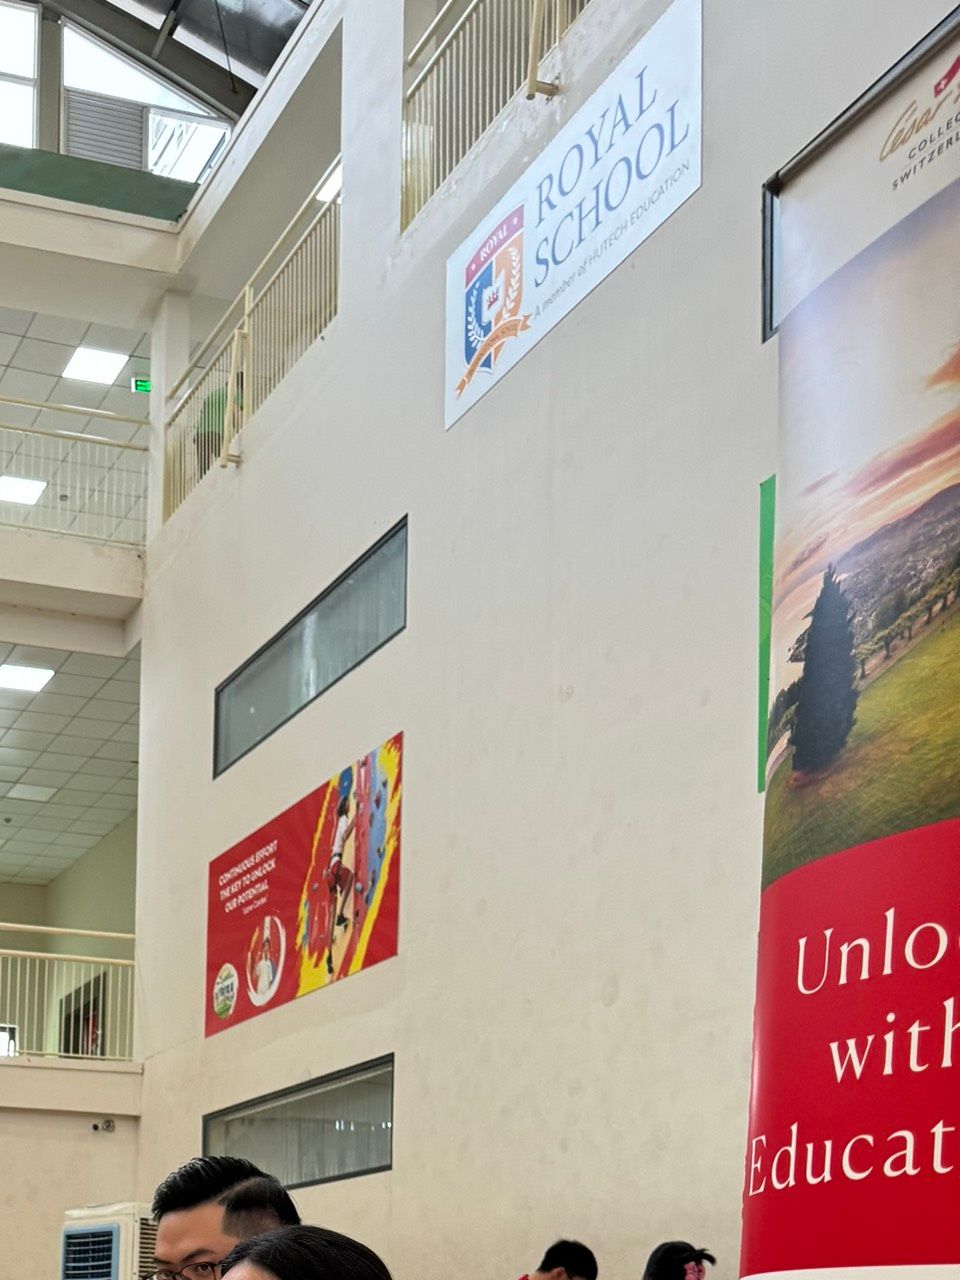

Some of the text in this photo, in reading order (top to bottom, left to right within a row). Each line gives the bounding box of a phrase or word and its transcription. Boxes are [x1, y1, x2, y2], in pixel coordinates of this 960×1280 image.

[535, 65, 658, 228] ROYAL
[535, 100, 690, 287] SCHOOL
[534, 160, 690, 320] A member of HUTECH EDUCATION
[797, 906, 960, 995] Unlo
[749, 1119, 955, 1197] Educat
